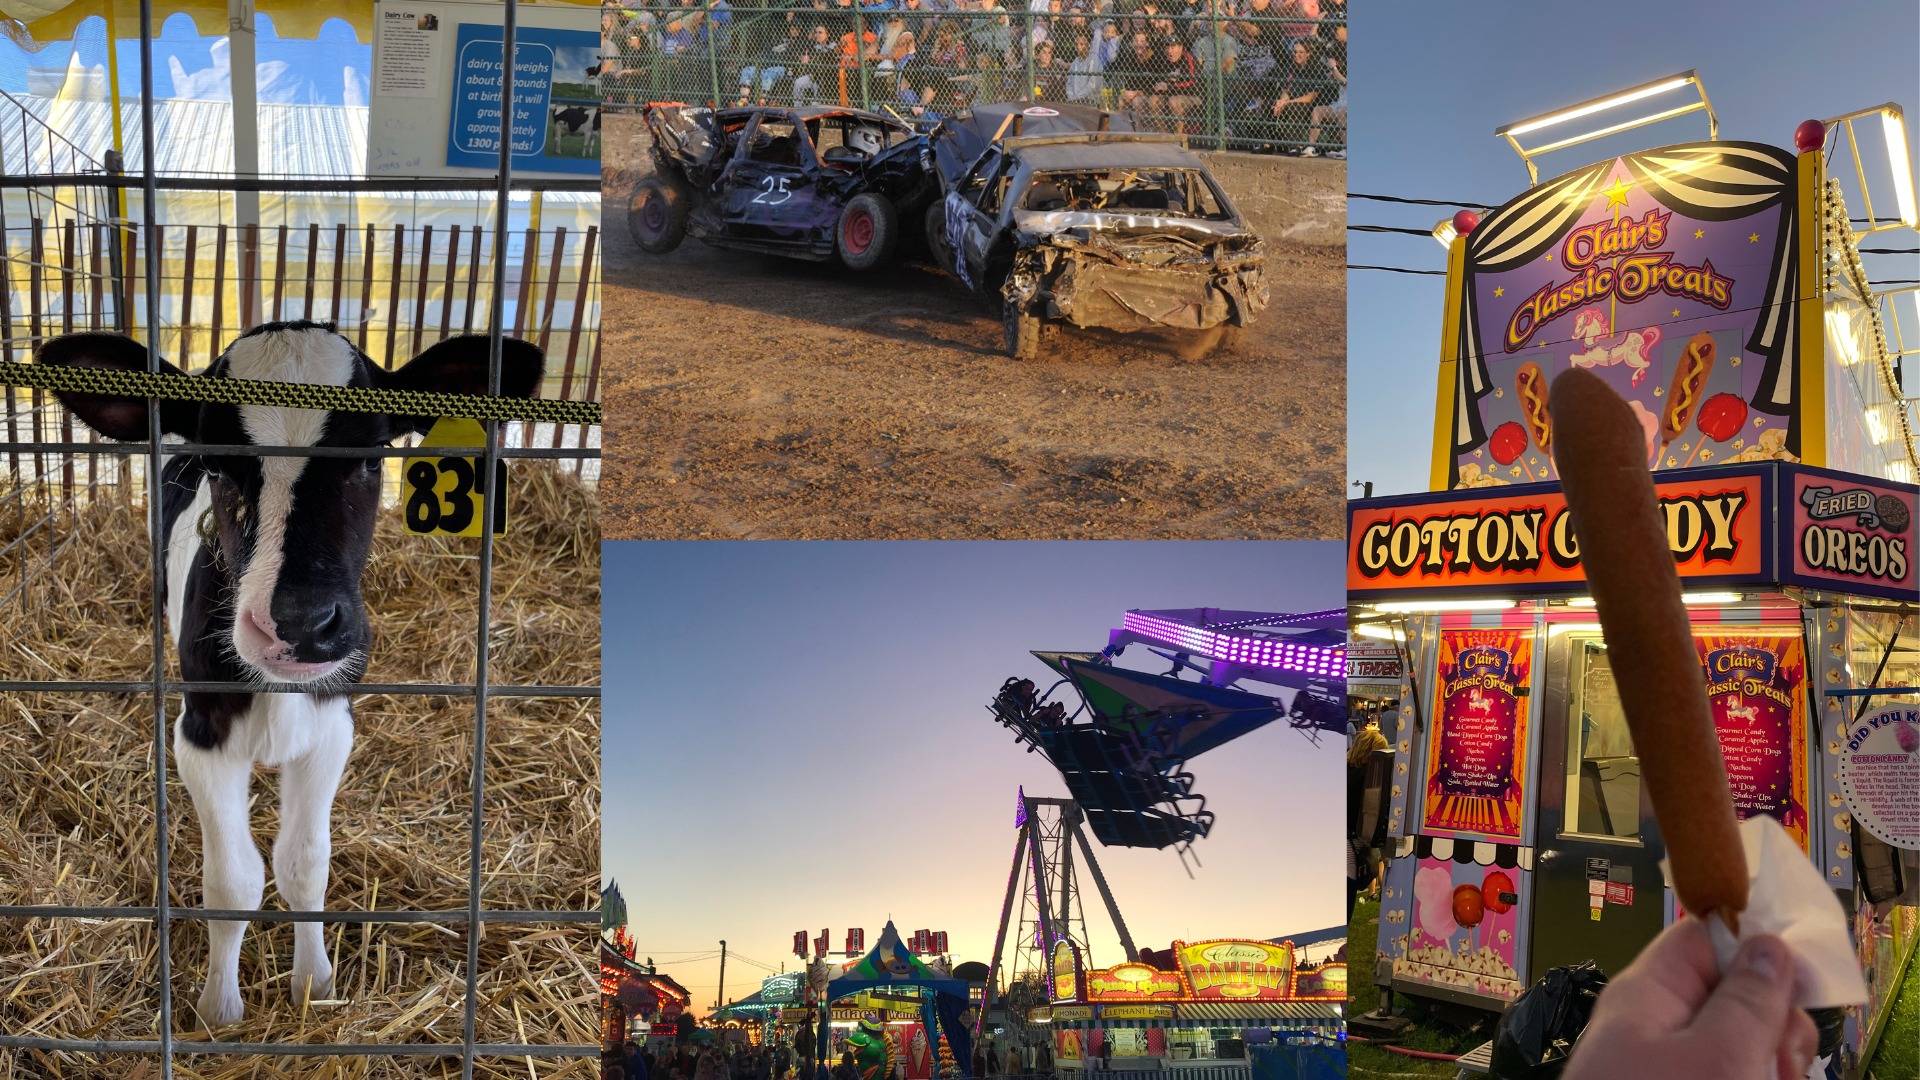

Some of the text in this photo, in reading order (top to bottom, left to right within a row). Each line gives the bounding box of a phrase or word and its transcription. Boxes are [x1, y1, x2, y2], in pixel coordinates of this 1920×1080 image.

[467, 58, 492, 71] dairy
[515, 62, 549, 74] weighs
[466, 74, 496, 86] about
[468, 92, 478, 100] at
[480, 91, 502, 102] birth
[525, 94, 542, 104] will
[517, 109, 530, 120] be
[467, 124, 537, 138] approxately
[467, 138, 492, 149] 1300
[752, 176, 792, 205] 25
[1565, 213, 1667, 268] Clair's
[1618, 255, 1731, 305] Treats
[1506, 267, 1614, 352] Classic
[1817, 493, 1872, 515] FRIED
[1362, 496, 1743, 572] COTTON CDY
[1804, 524, 1908, 580] OREOS
[1358, 662, 1401, 676] TENDERS
[1464, 652, 1501, 670] Clair's
[1716, 652, 1765, 672] Clair's
[1445, 674, 1482, 699] Classic
[1744, 678, 1792, 708] Treats
[1744, 728, 1765, 737] Candy
[1848, 710, 1920, 752] DID YOU K
[1747, 737, 1768, 745] Apples
[1720, 745, 1743, 754] Dipped
[1763, 748, 1781, 756] Dogs
[1740, 755, 1762, 765] Candy
[1851, 755, 1881, 764] COTTON
[1881, 754, 1909, 763] CANDY
[1728, 773, 1754, 781] Popcorn
[1739, 783, 1757, 792] Dogs
[1753, 802, 1775, 810] Water
[1206, 942, 1268, 962] Classic
[1189, 961, 1286, 990] BAKERY
[1091, 978, 1180, 996] Funnel Cakes
[1104, 1008, 1170, 1017] ELEPHANT EARS
